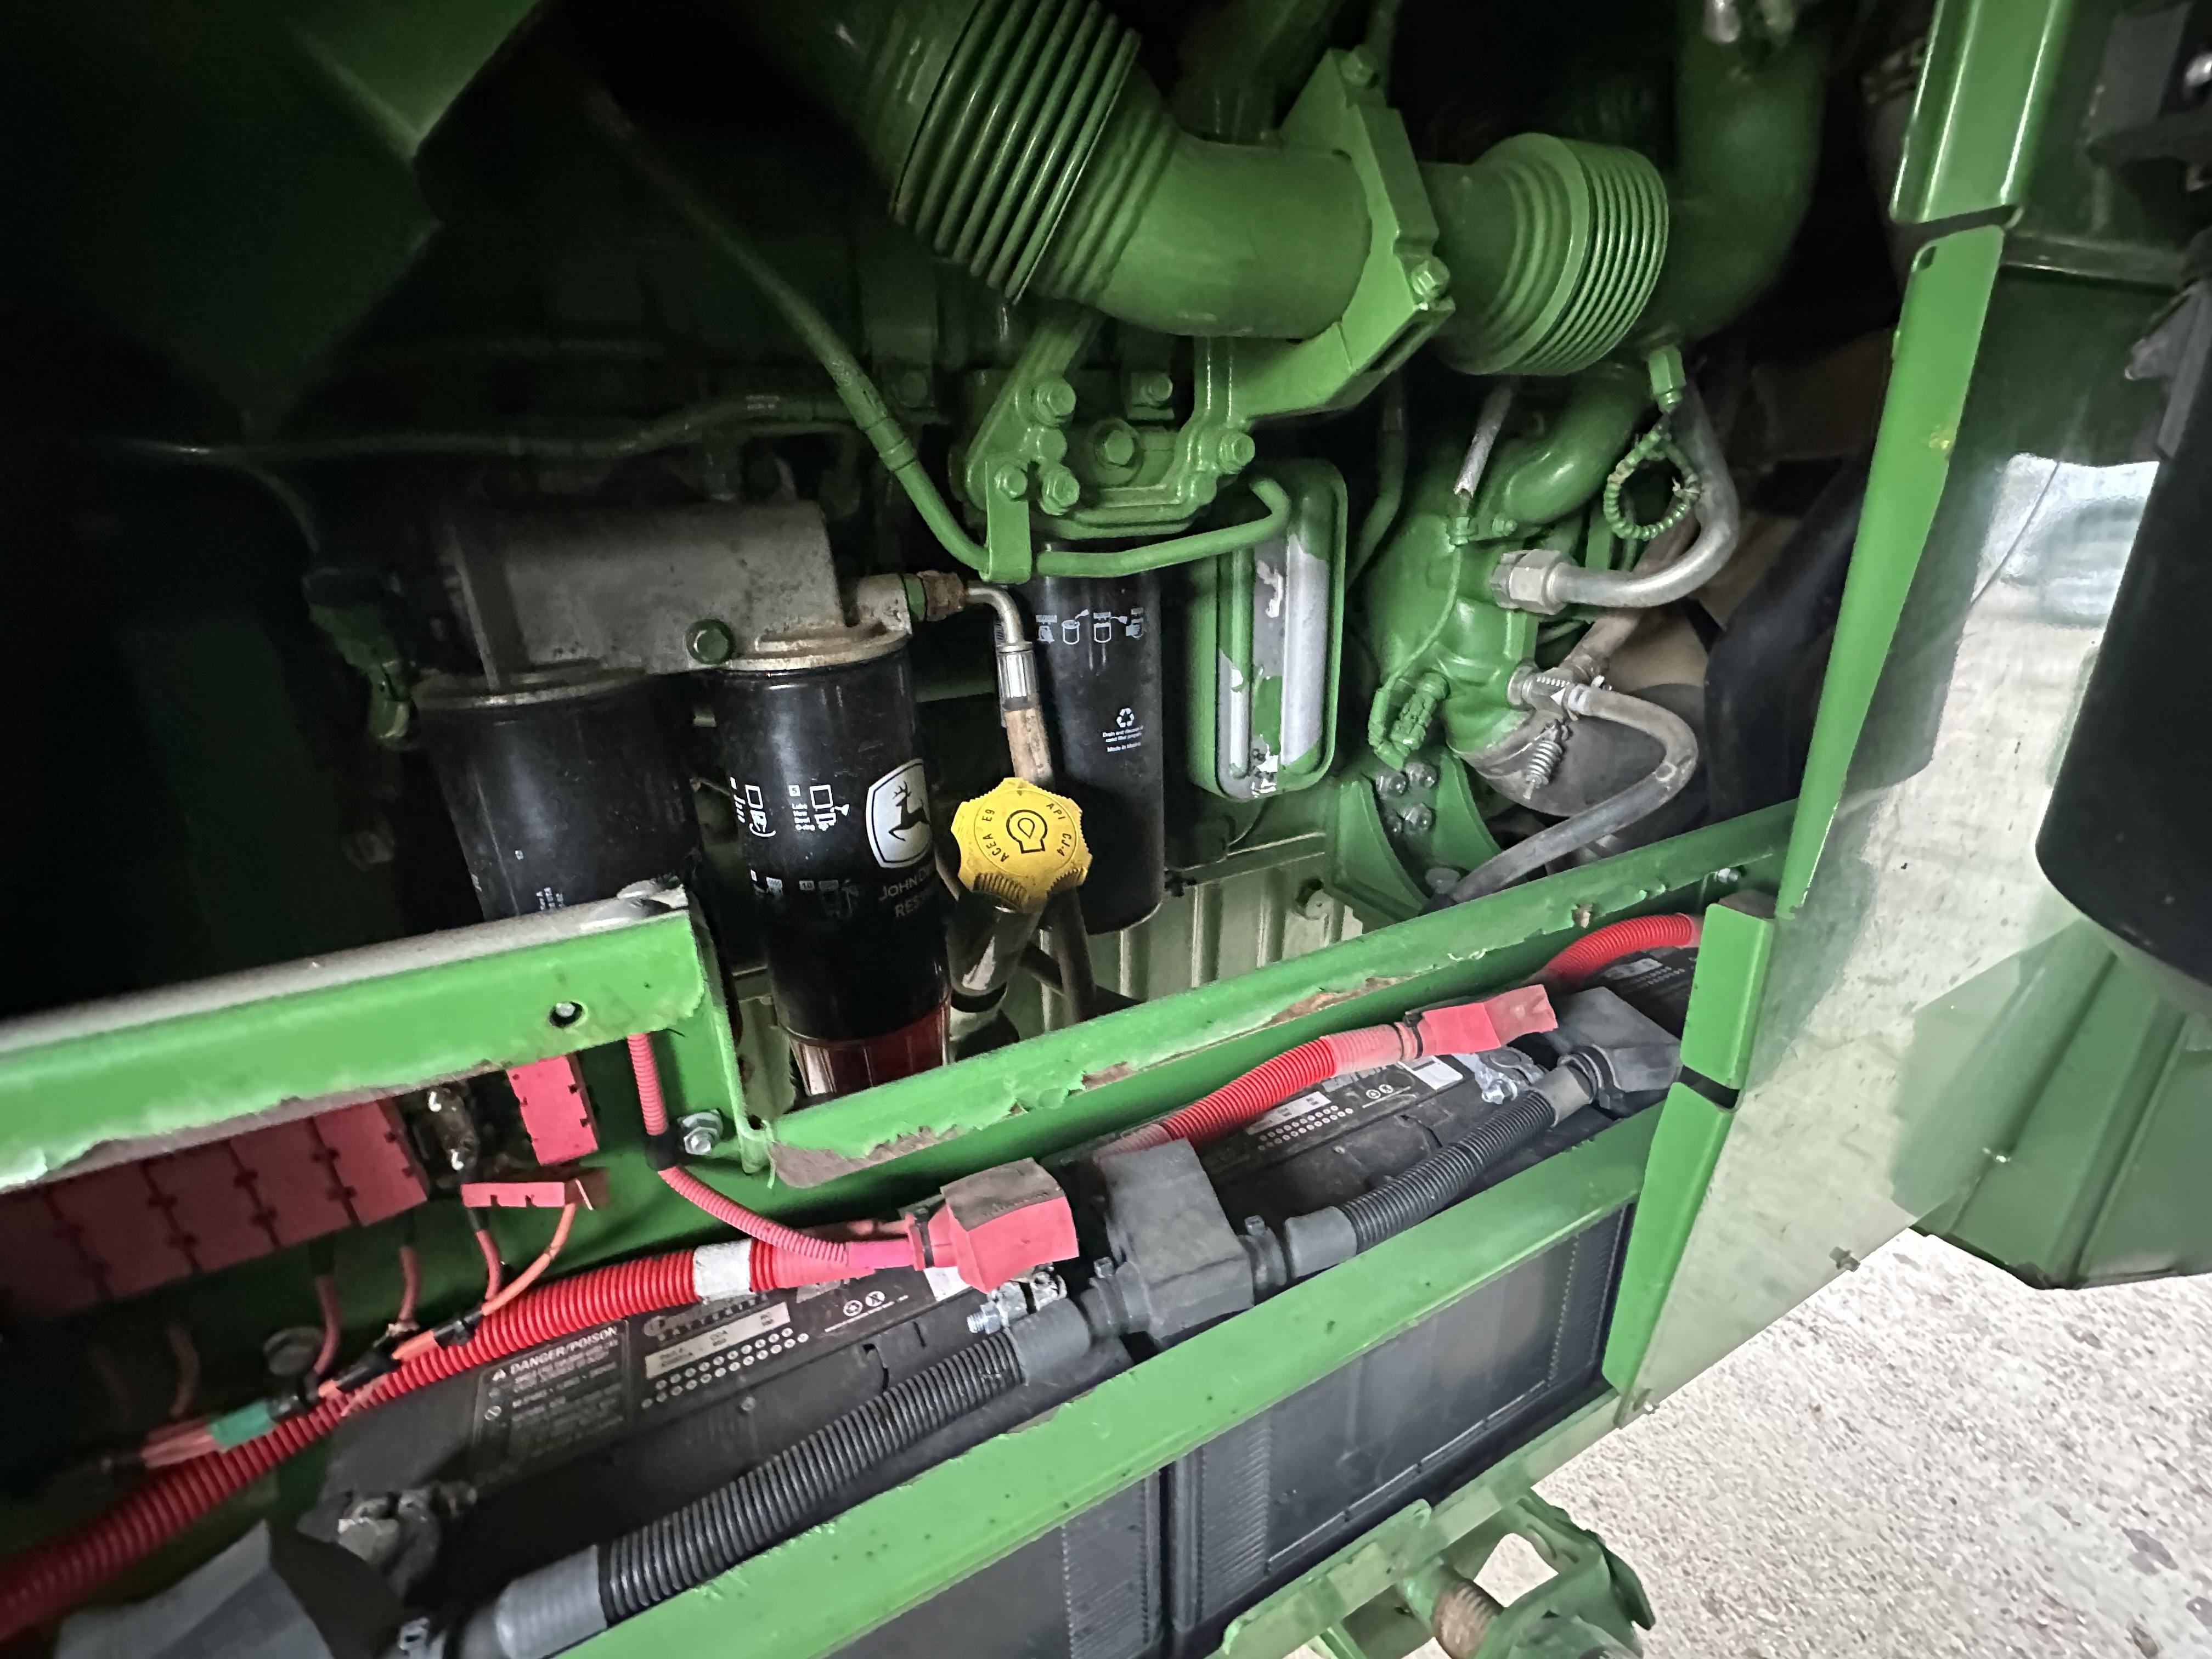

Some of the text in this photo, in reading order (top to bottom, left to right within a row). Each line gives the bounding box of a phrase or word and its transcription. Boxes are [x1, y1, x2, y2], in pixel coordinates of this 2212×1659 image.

[981, 809, 1009, 862] ACEA E9
[1046, 803, 1072, 856] API CJ-4
[878, 875, 918, 901] JOHN
